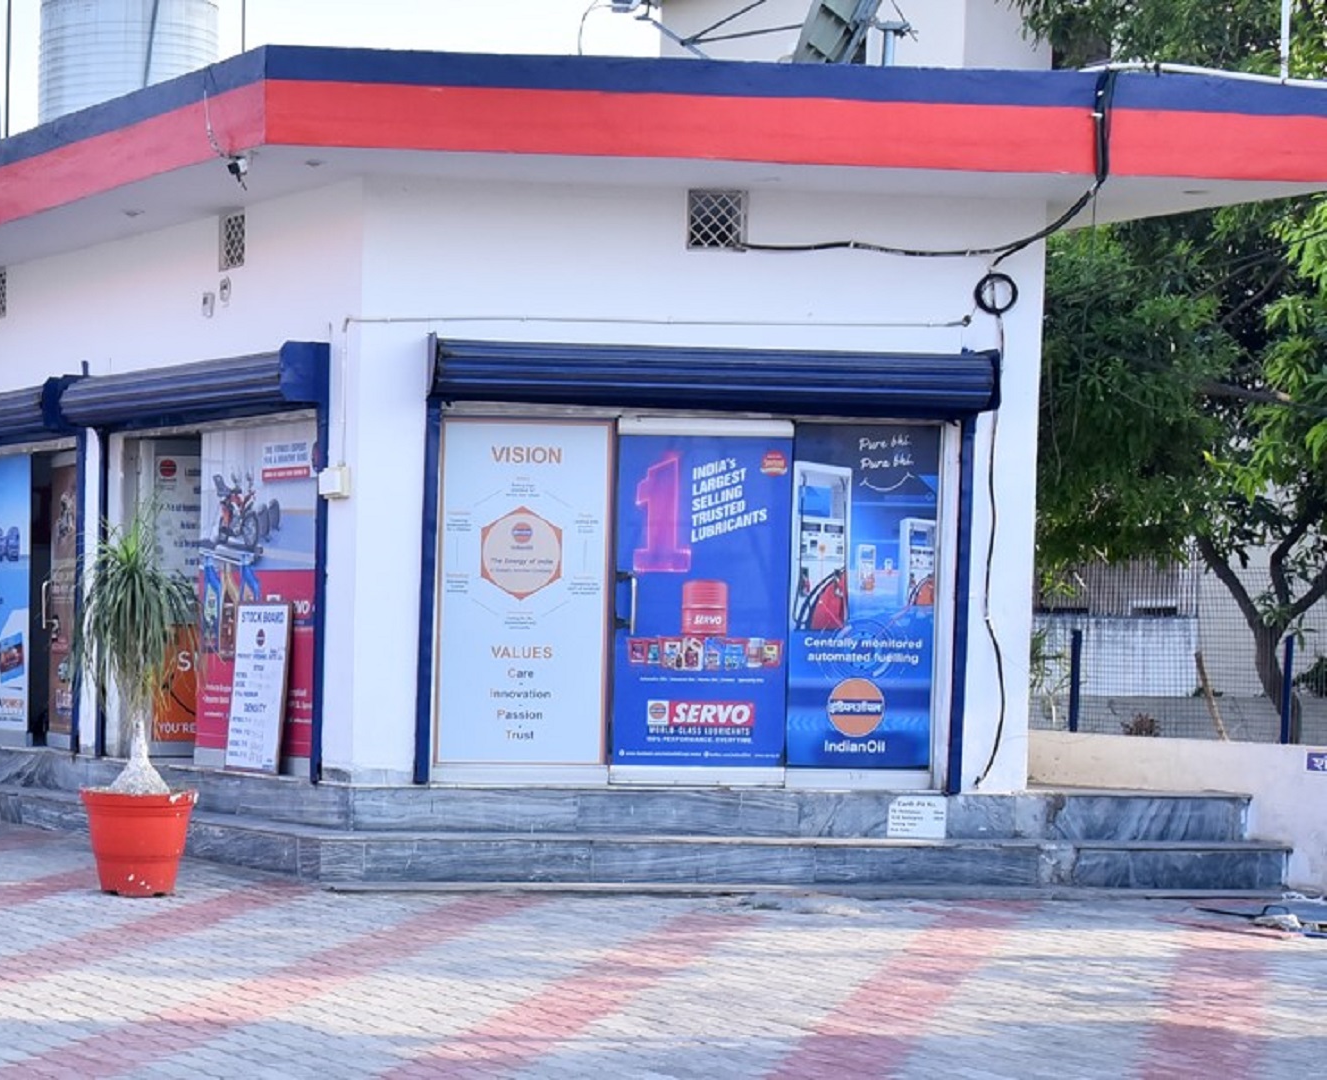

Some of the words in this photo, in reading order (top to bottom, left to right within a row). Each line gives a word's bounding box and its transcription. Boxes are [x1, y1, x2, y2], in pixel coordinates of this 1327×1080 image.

[491, 446, 562, 464] VISION
[692, 458, 736, 480] INDIA's
[692, 467, 747, 496] LARGEST
[692, 485, 743, 511] SELLING
[692, 500, 746, 526] TRUSTED
[691, 508, 767, 543] LUBRICANTS
[504, 558, 527, 566] Energy
[241, 611, 262, 623] STOCK
[263, 611, 285, 624] BOARD
[693, 614, 723, 625] SERVO
[804, 637, 858, 649] Centrally
[861, 638, 923, 649] monitored
[491, 646, 553, 659] VALUES
[807, 653, 871, 662] automated
[874, 652, 919, 665] fuelling
[507, 668, 534, 679] Care
[490, 688, 551, 699] Innovation
[497, 709, 543, 720] Passion
[673, 702, 751, 724] SERVO
[159, 722, 197, 734] YOU'RE
[505, 729, 534, 740] Trust
[704, 726, 750, 736] LUBRICANTS
[824, 740, 886, 753] IndianOil
